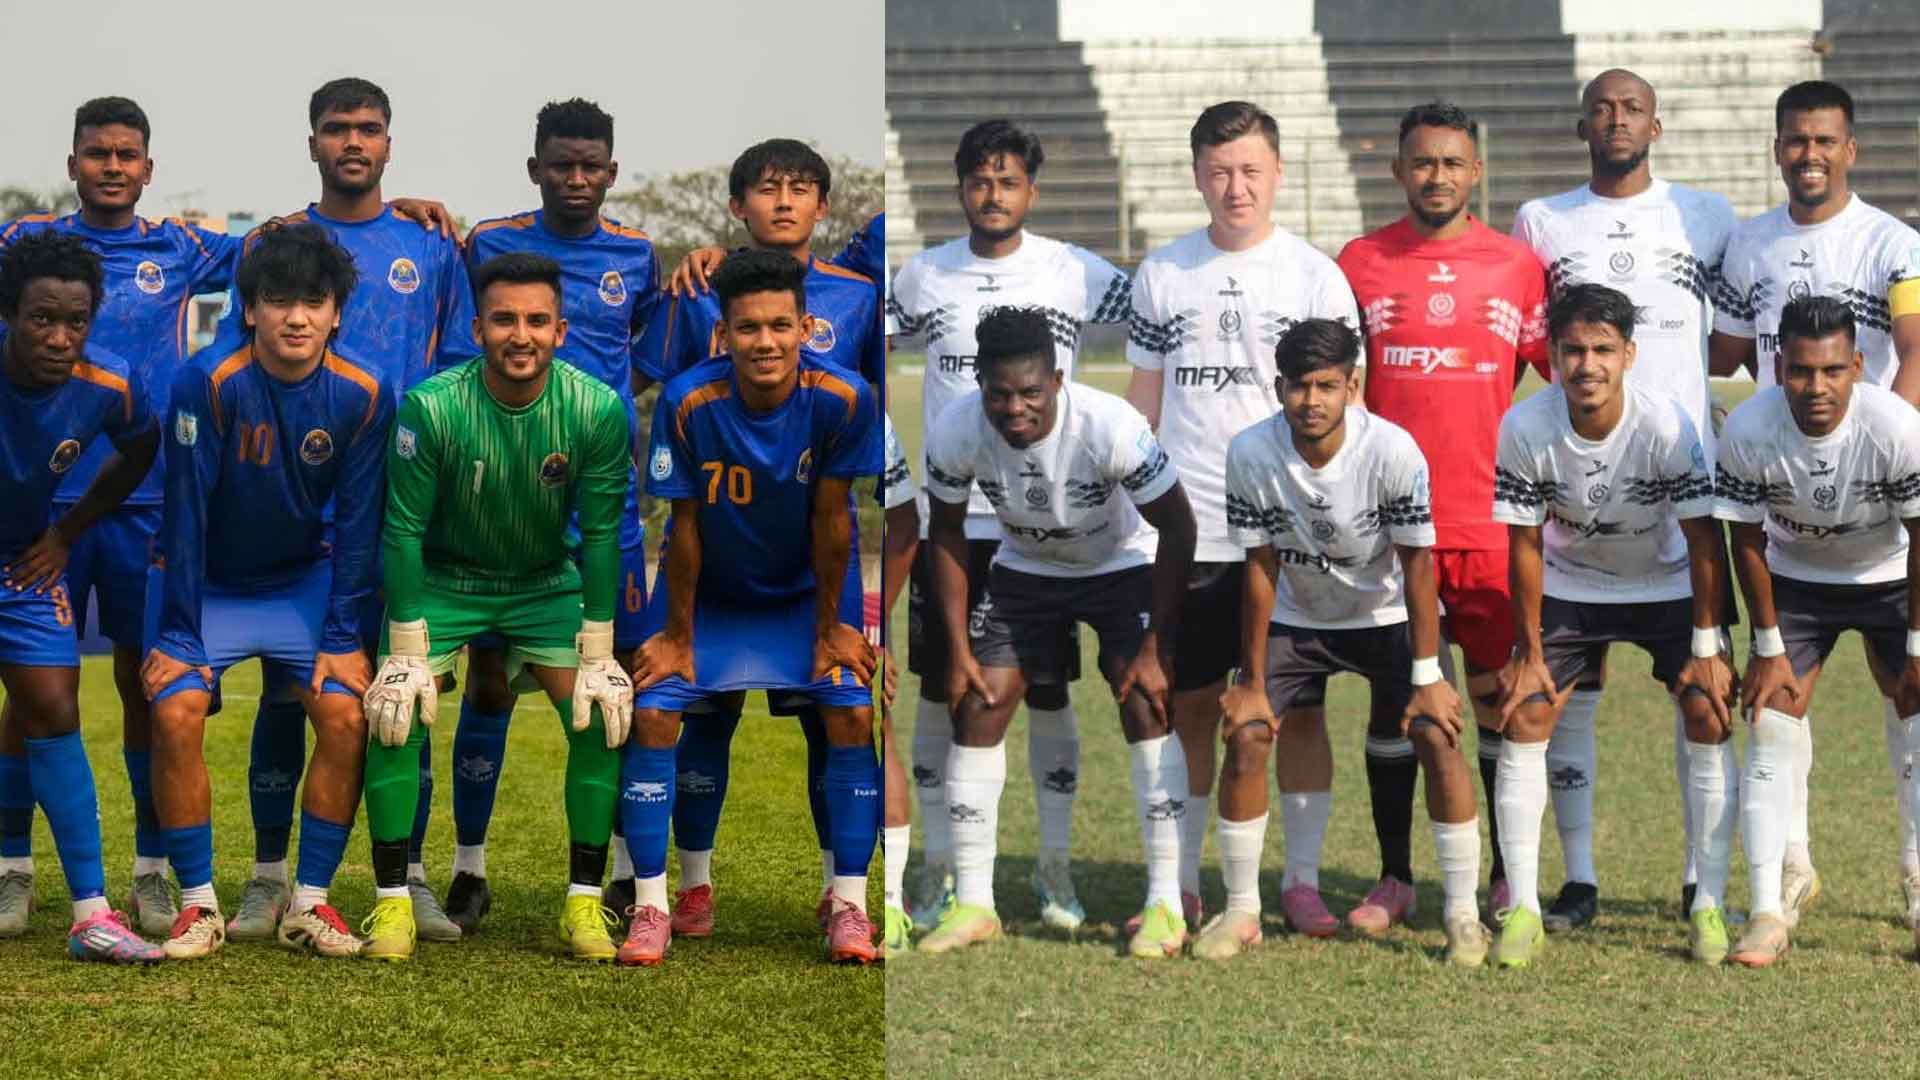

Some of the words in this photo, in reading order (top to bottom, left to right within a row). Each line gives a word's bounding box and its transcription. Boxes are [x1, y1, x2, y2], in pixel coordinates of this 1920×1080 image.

[939, 354, 978, 373] MA
[1383, 346, 1456, 375] MAX
[238, 421, 273, 465] 10
[473, 460, 484, 494] 1
[701, 461, 753, 505] 70
[626, 572, 641, 613] 6
